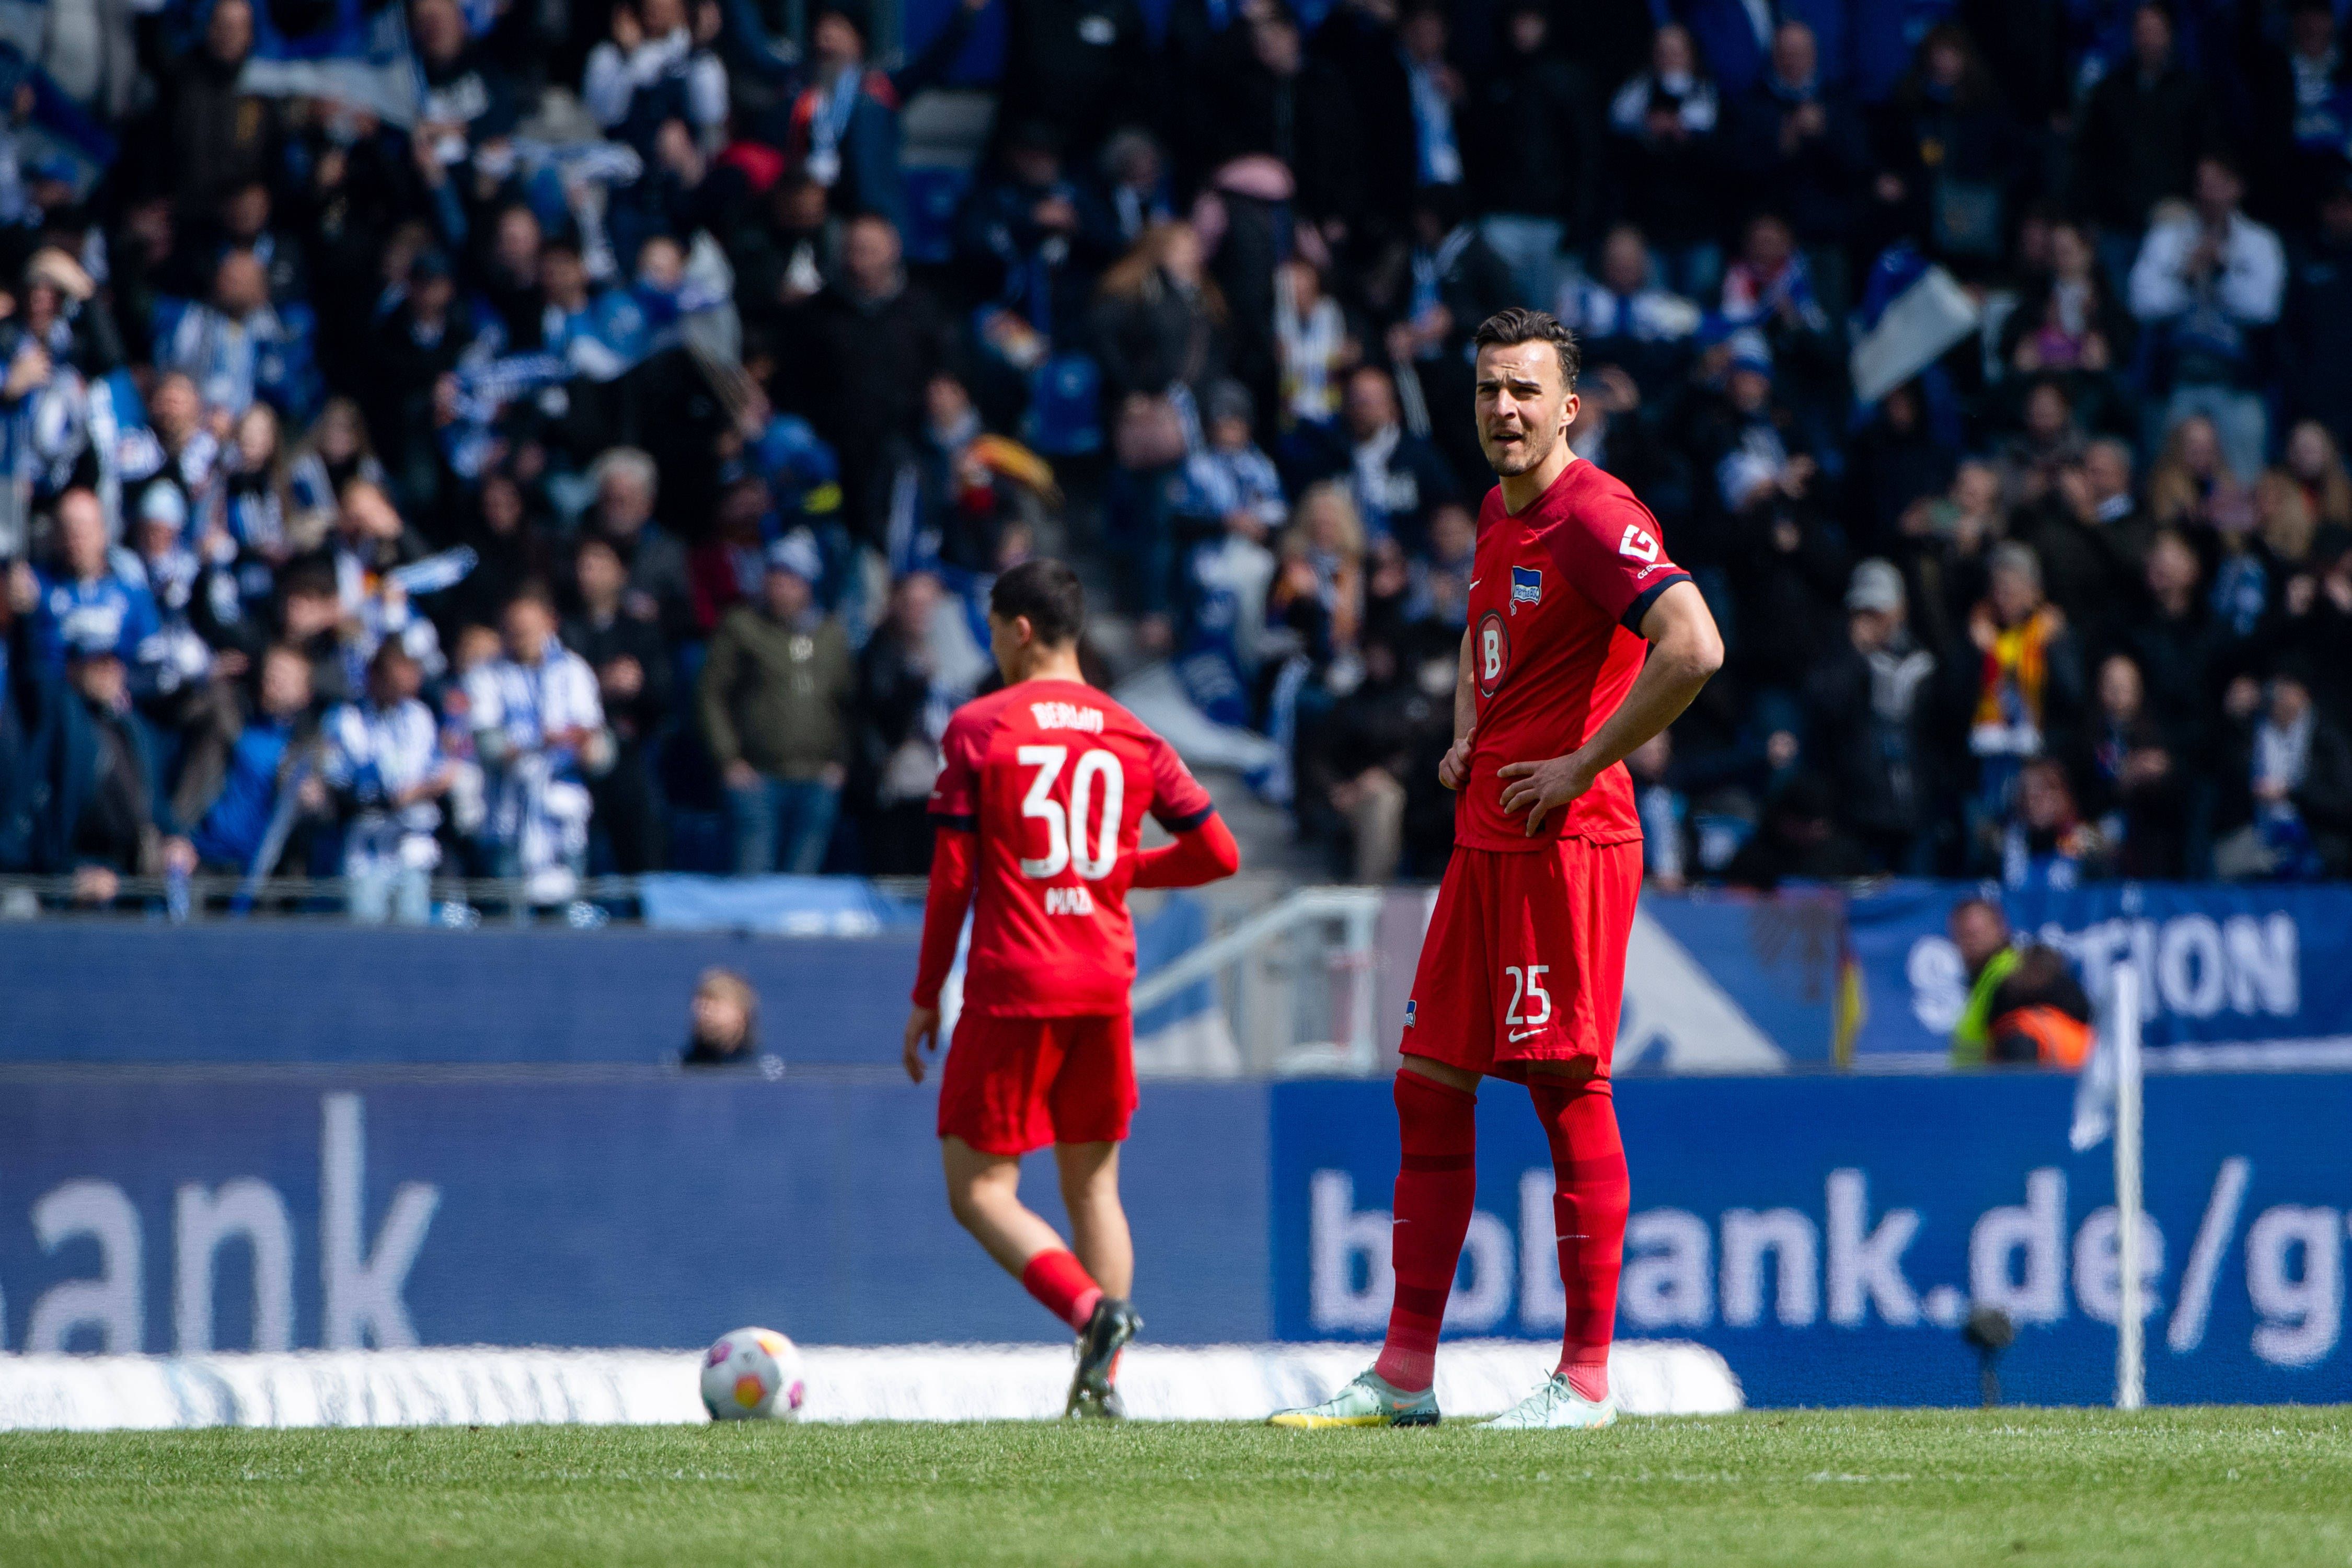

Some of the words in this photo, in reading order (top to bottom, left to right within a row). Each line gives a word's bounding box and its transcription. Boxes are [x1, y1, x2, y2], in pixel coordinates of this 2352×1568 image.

[1483, 630, 1501, 679] B
[1017, 745, 1124, 881] 30
[1505, 965, 1551, 1025] 25
[1907, 909, 2300, 1034] STION
[0, 1090, 443, 1355] ank
